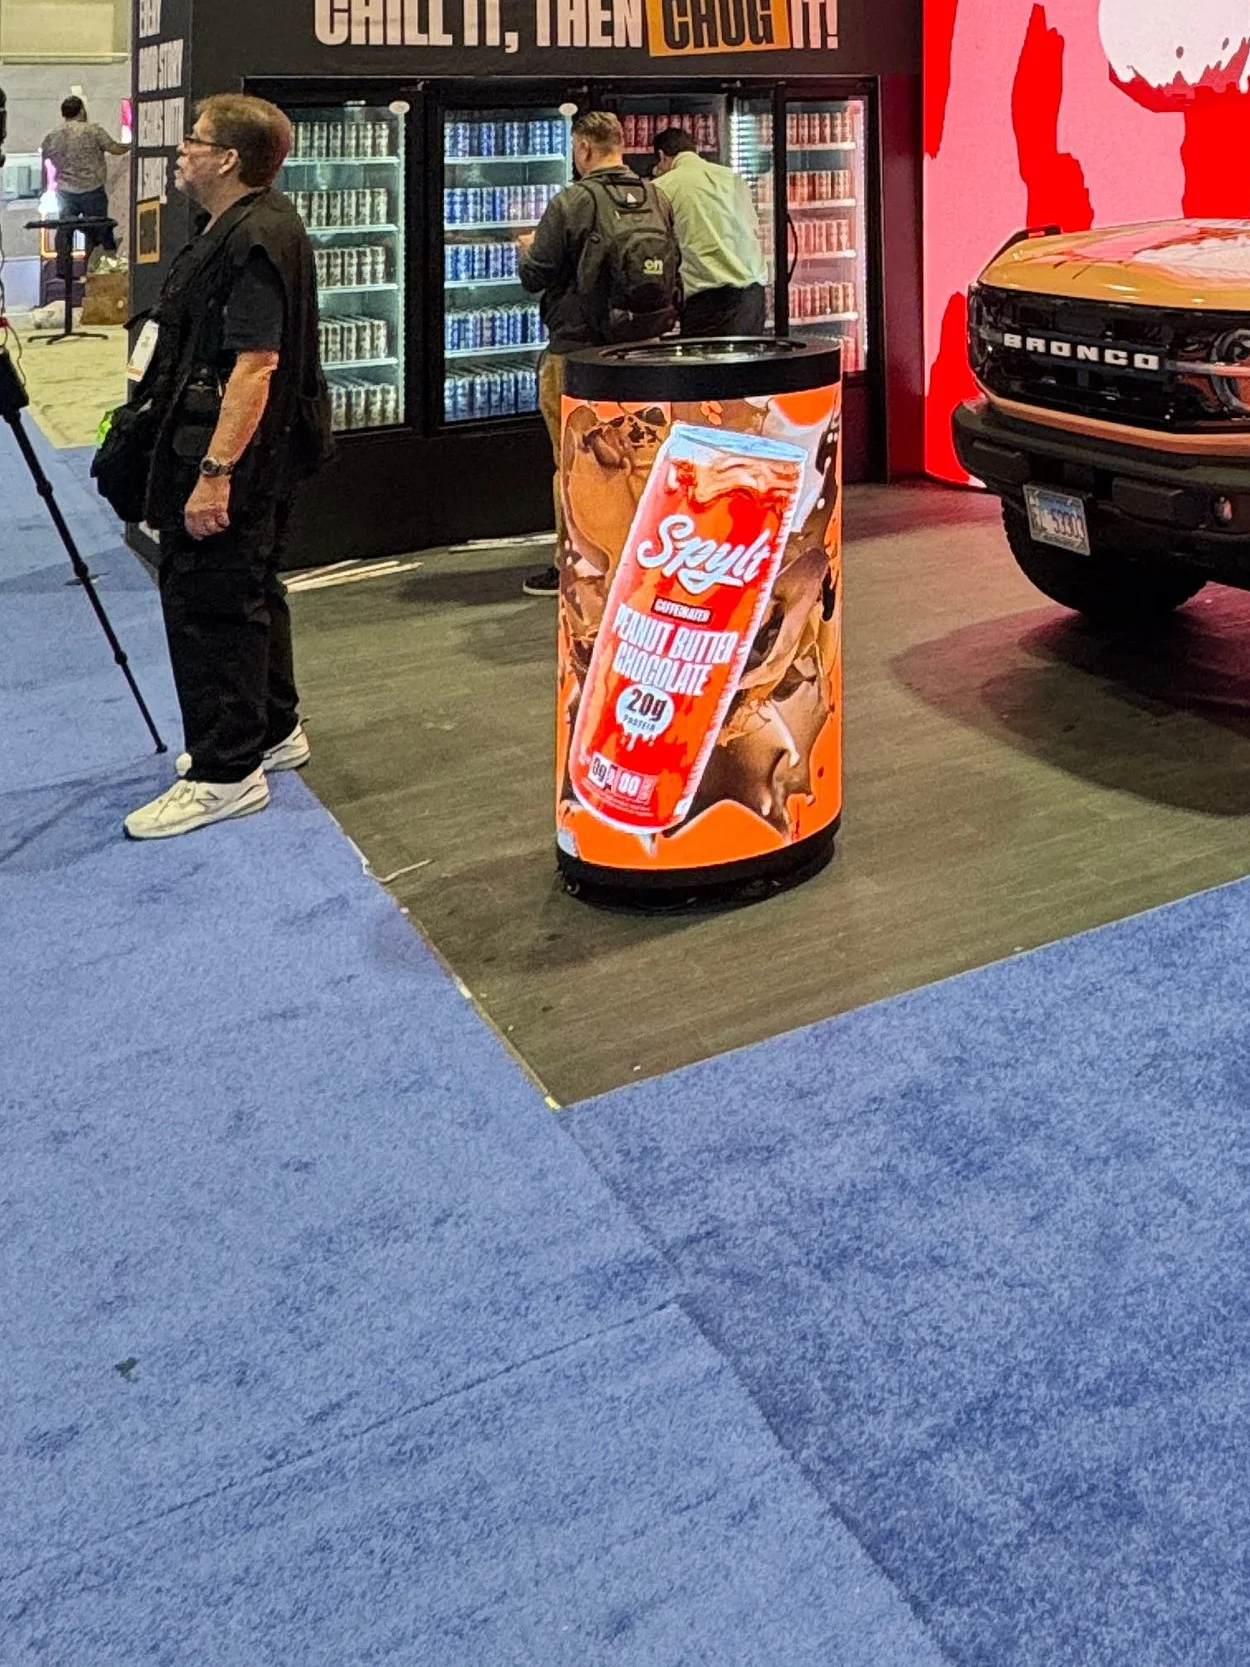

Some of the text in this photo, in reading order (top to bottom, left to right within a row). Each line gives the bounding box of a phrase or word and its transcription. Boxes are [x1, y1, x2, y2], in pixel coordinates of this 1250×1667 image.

[1004, 333, 1159, 370] BRONCO
[637, 514, 771, 595] Spylt
[612, 603, 739, 664] PEANUT BUTTER
[613, 641, 712, 696] CHOCOLATE
[623, 714, 656, 731] PROTEIN
[626, 688, 668, 722] 20g
